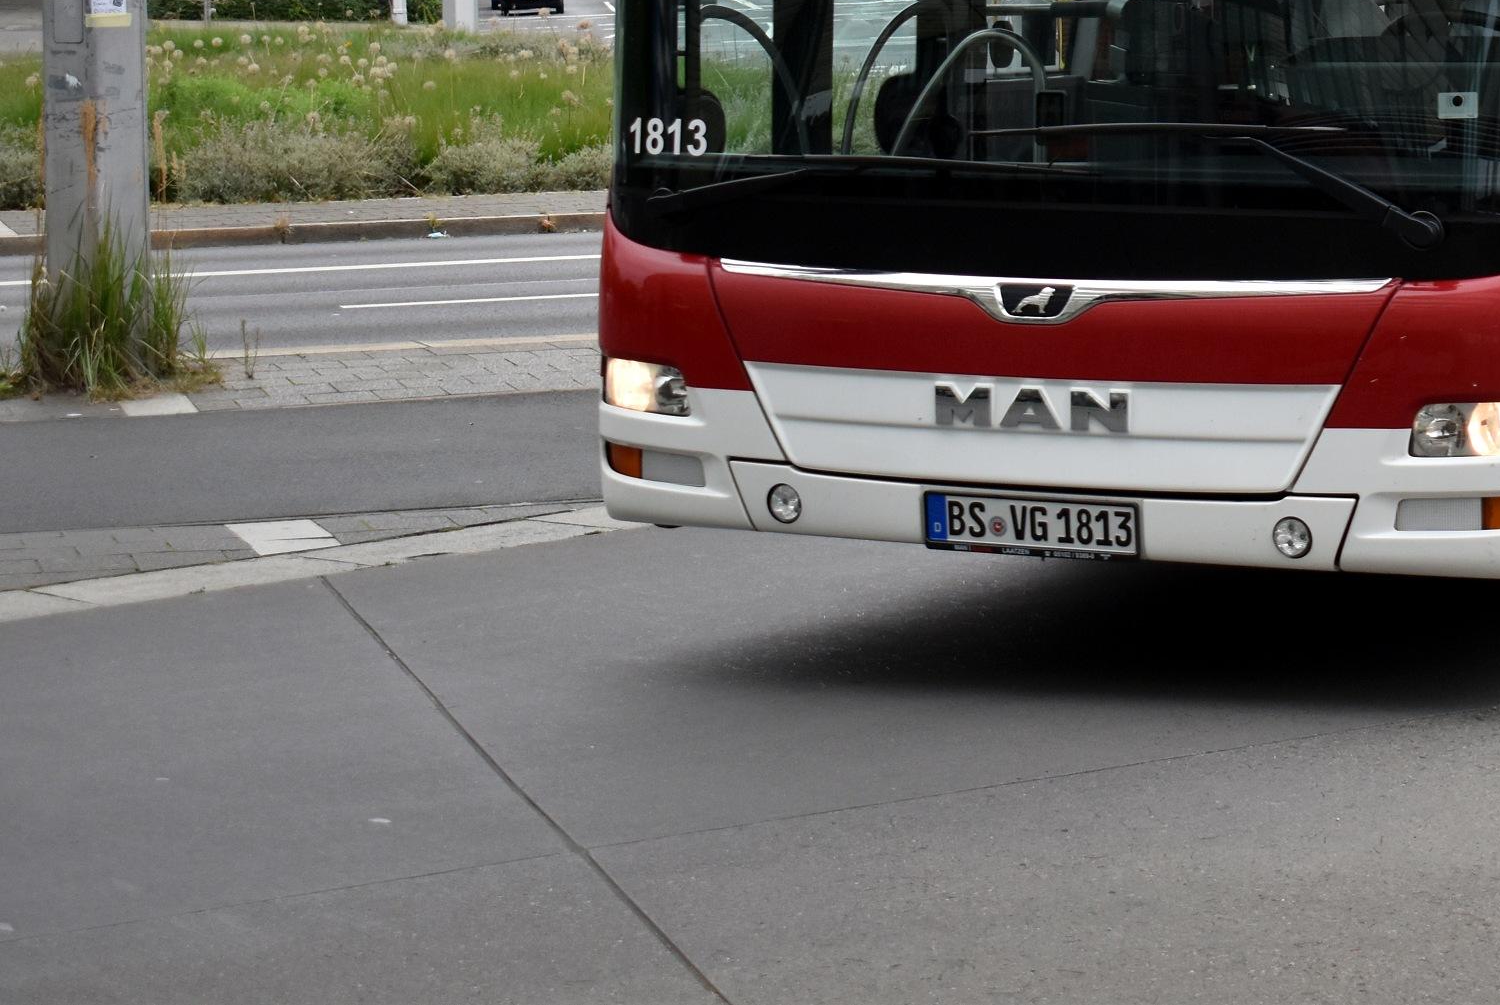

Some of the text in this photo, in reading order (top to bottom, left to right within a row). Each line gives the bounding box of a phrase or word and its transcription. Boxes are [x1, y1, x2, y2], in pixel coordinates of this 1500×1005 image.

[630, 117, 707, 156] 1813
[934, 381, 1132, 434] MAN
[935, 523, 942, 532] D
[947, 500, 1132, 547] BS VG 1813
